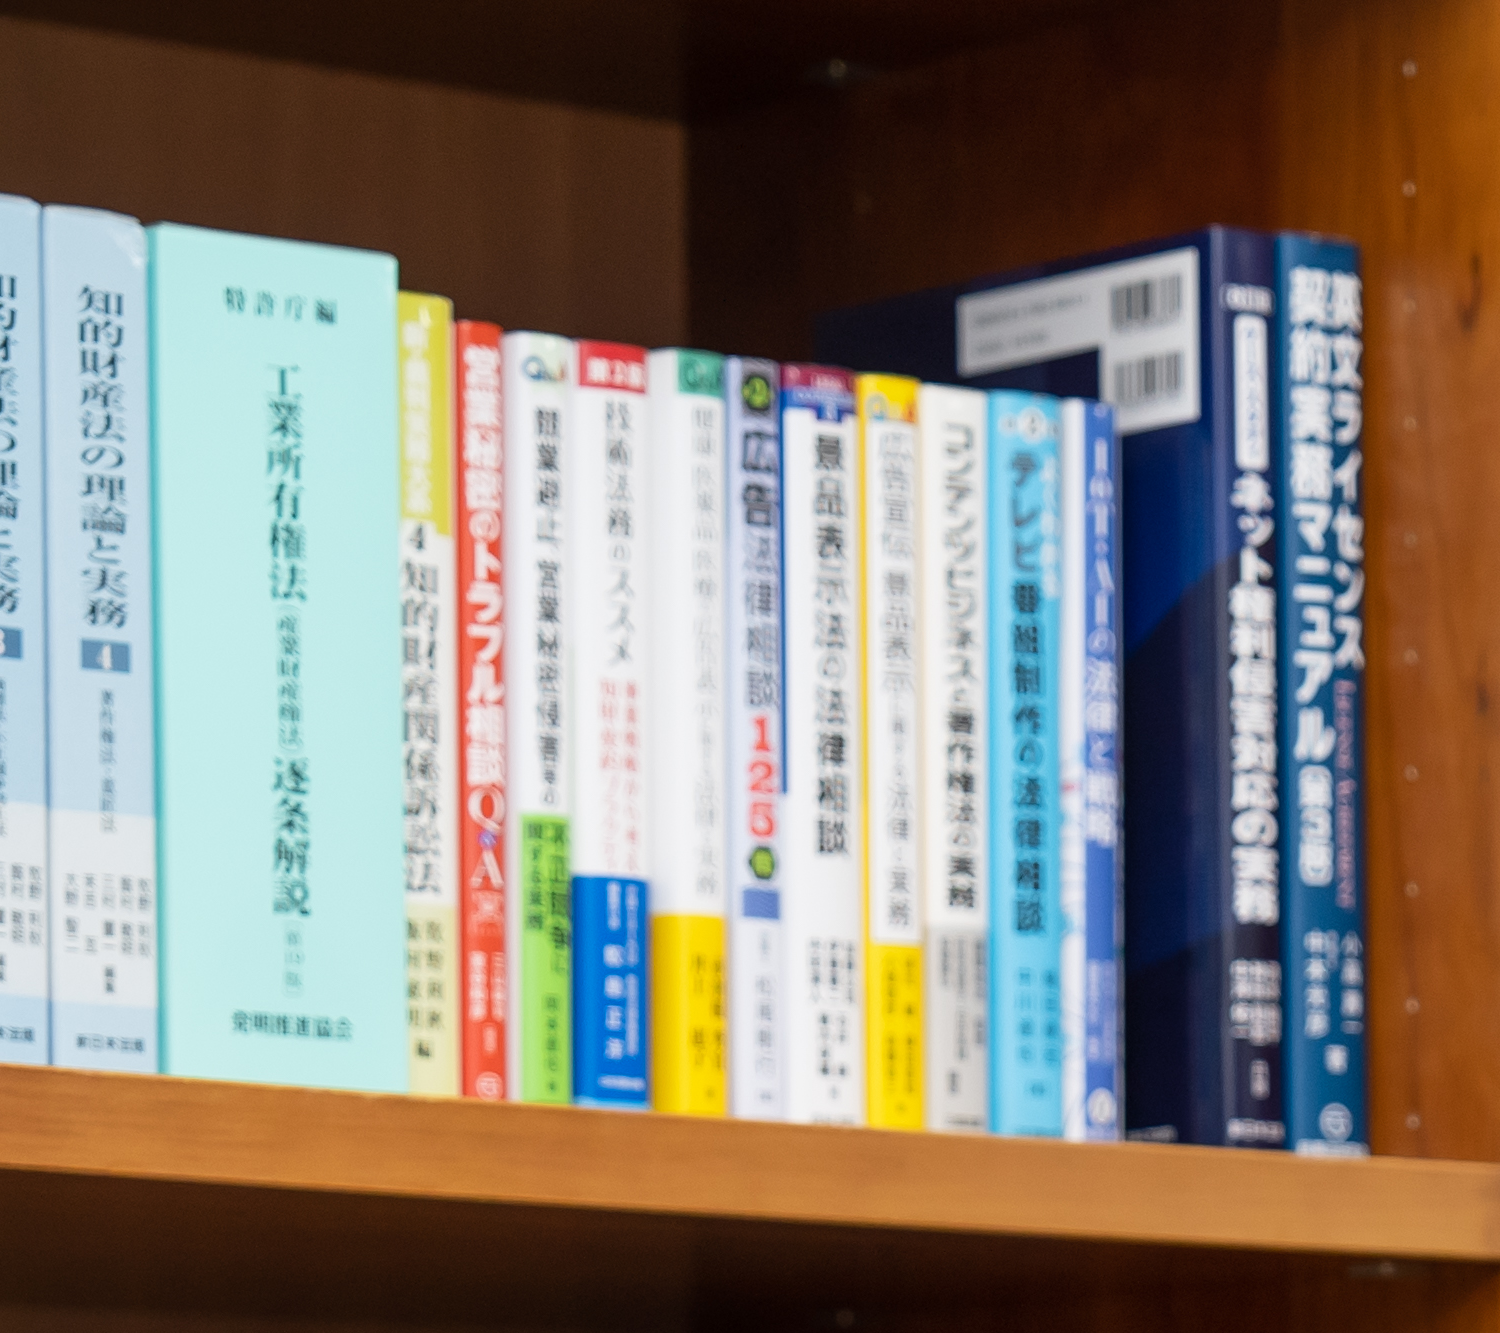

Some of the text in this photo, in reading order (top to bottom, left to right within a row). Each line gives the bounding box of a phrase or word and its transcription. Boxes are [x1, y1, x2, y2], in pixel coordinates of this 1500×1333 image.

[78, 285, 127, 629] 知的財産法の理論と実務
[267, 363, 308, 602] 工業所有権法
[97, 645, 114, 671] 4
[273, 758, 311, 916] 逐条解説
[747, 714, 777, 839] 125
